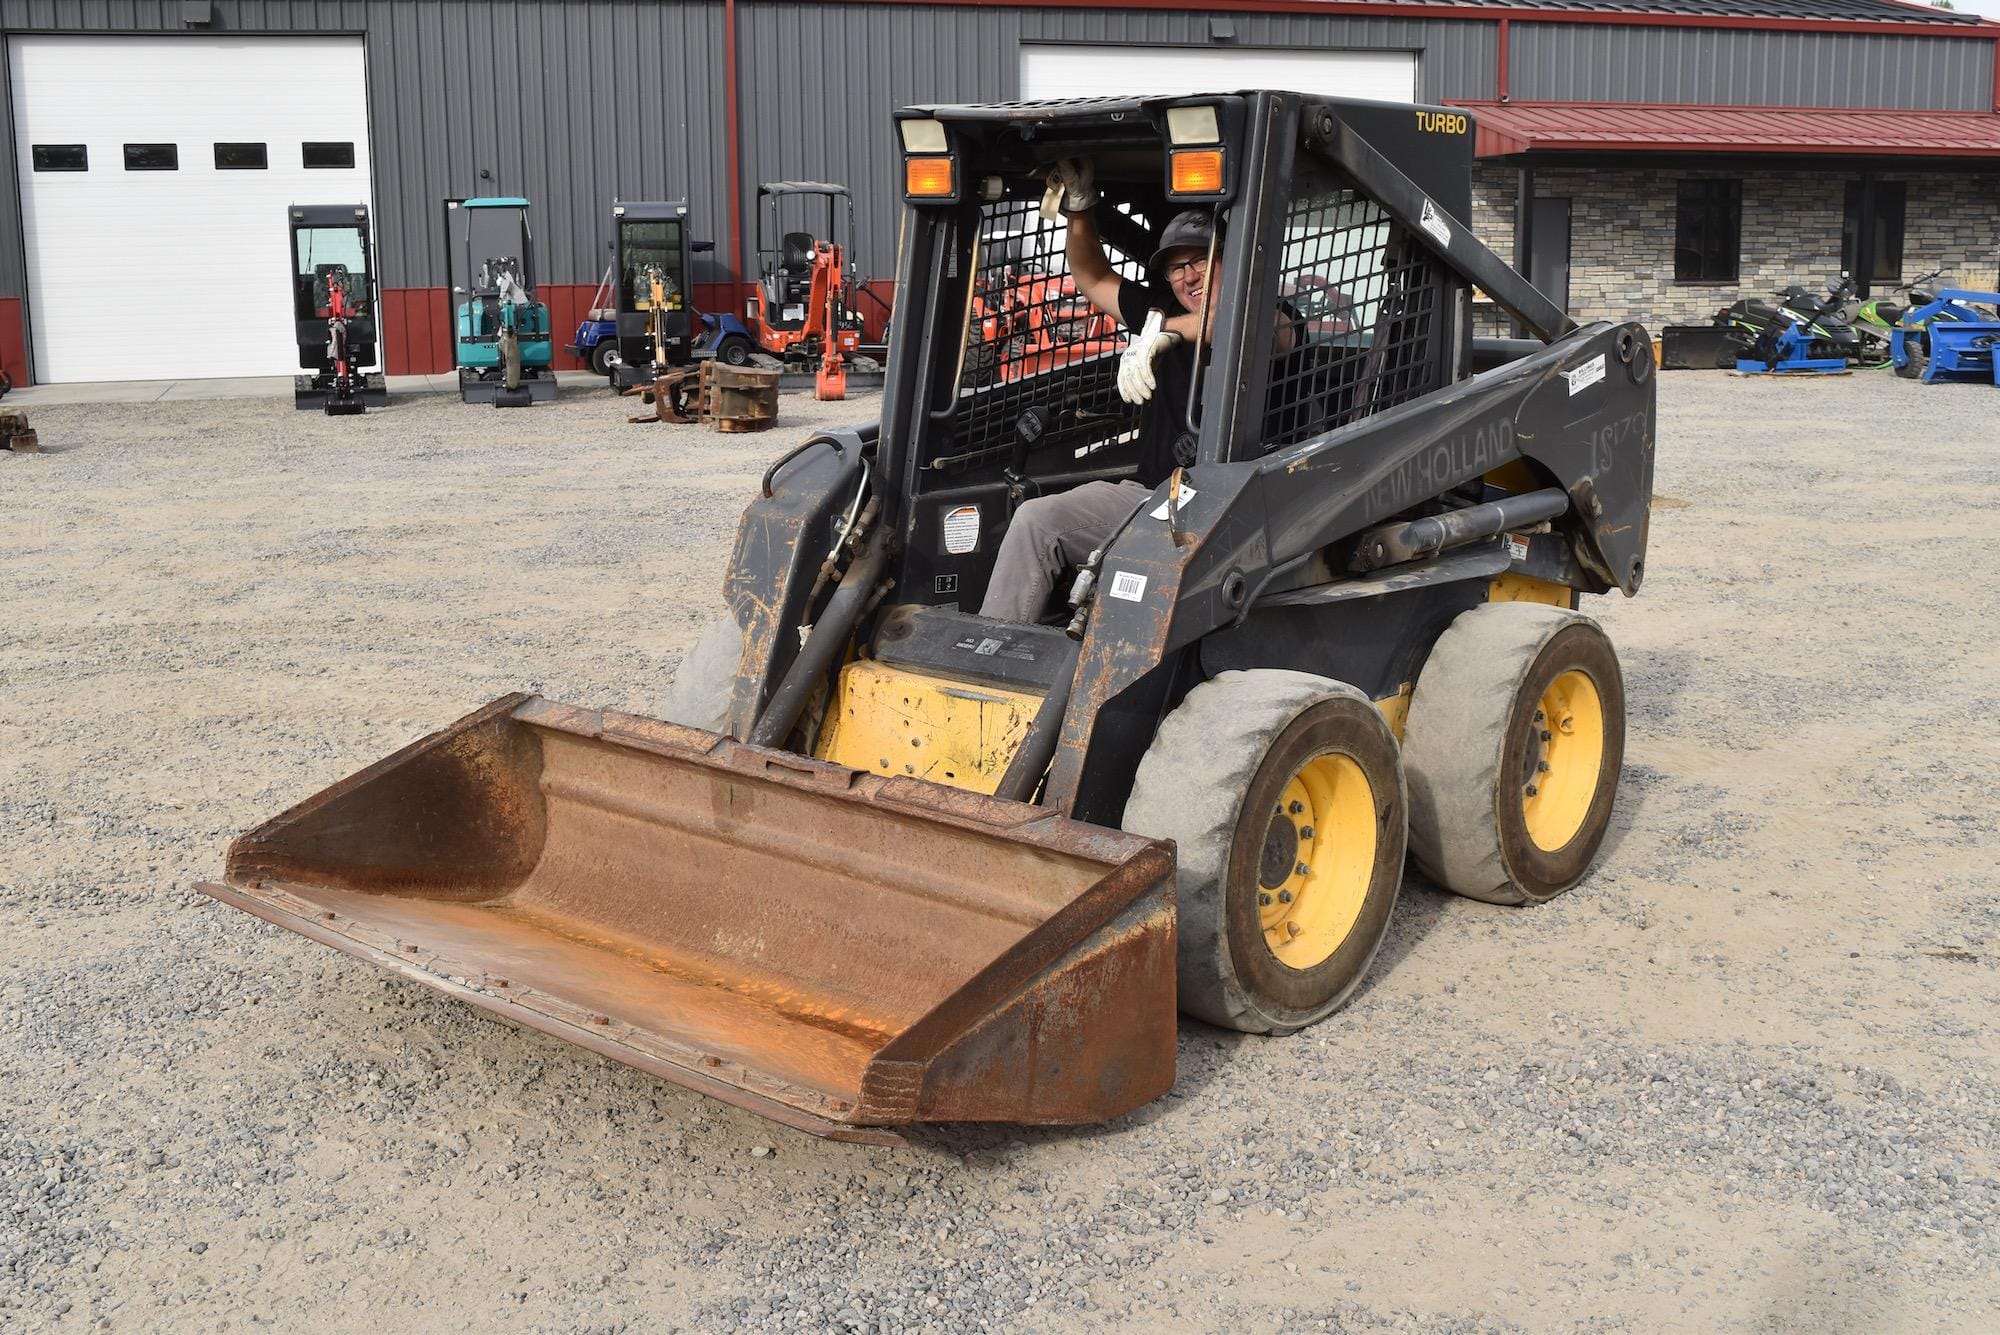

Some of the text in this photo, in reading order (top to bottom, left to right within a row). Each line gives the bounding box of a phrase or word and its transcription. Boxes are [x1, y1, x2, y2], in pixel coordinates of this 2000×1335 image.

[1416, 111, 1467, 135] TURBO
[1365, 417, 1514, 519] NEW HOLLAND
